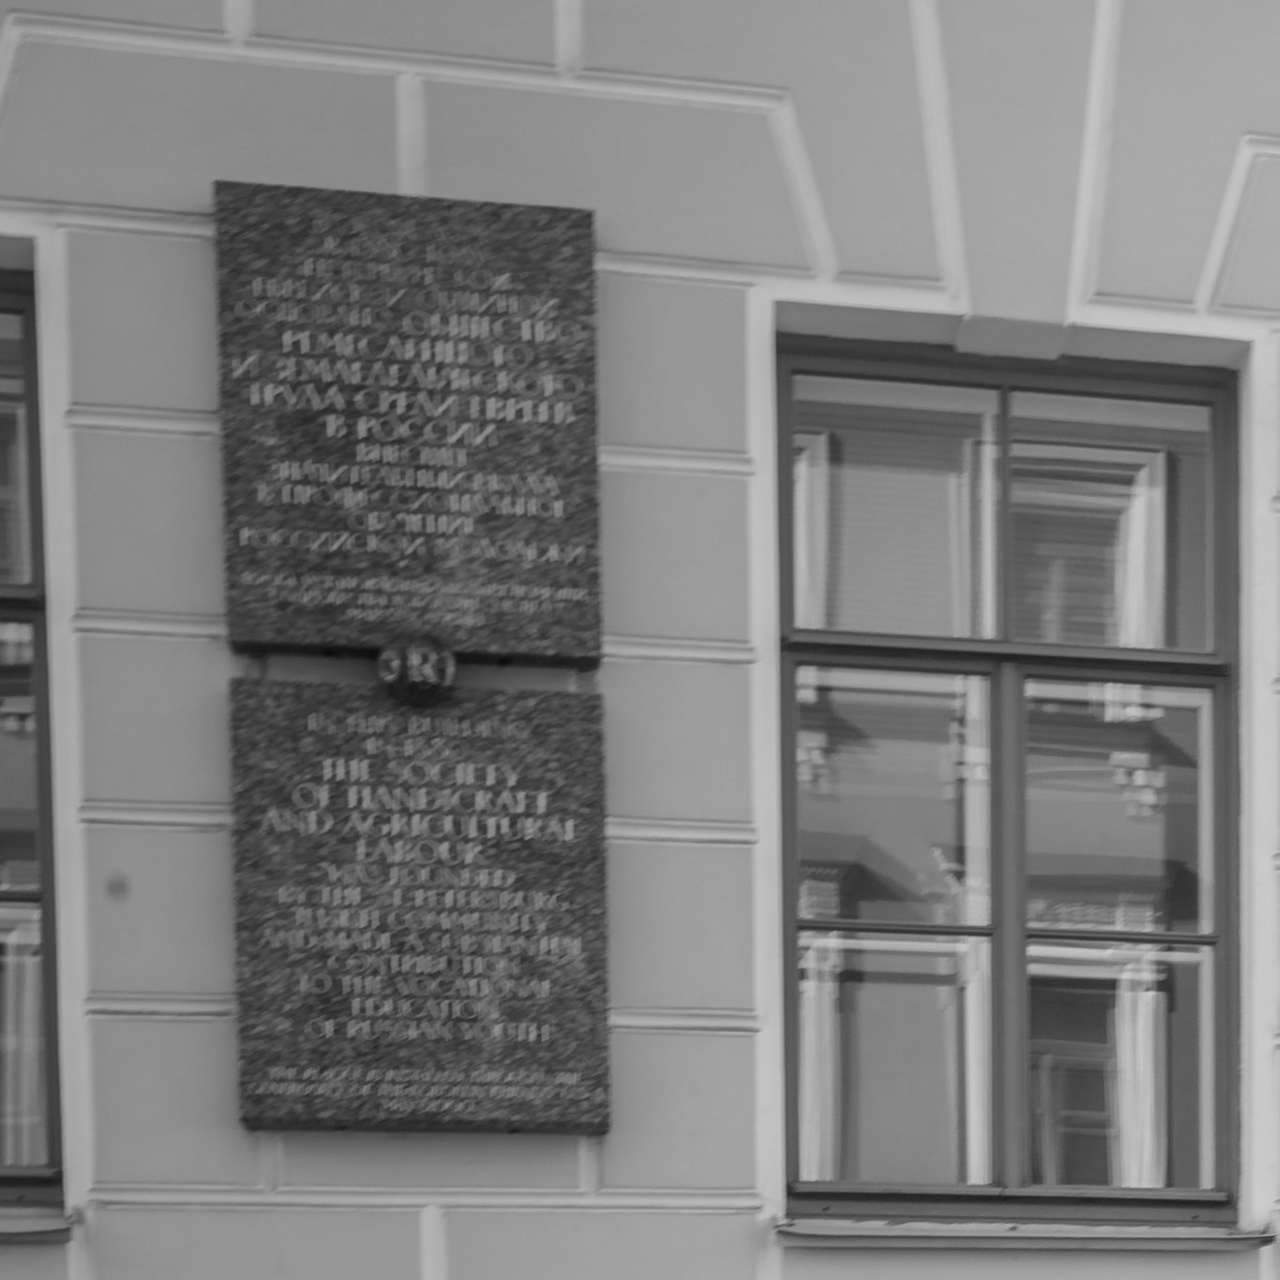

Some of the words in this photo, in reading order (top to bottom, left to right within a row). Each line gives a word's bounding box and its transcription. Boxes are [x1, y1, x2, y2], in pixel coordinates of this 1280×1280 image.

[249, 382, 344, 411] ТРУДА
[355, 387, 460, 417] СРЕДИ
[358, 414, 498, 448] РОССИИ
[323, 757, 373, 783] THE
[387, 757, 527, 789] SOCIETY
[292, 783, 332, 809] OF
[349, 784, 552, 815] HANDICRAFT
[260, 805, 334, 836] AND
[342, 808, 577, 842] AGRICULTURAL
[355, 838, 493, 867] LABOUR
